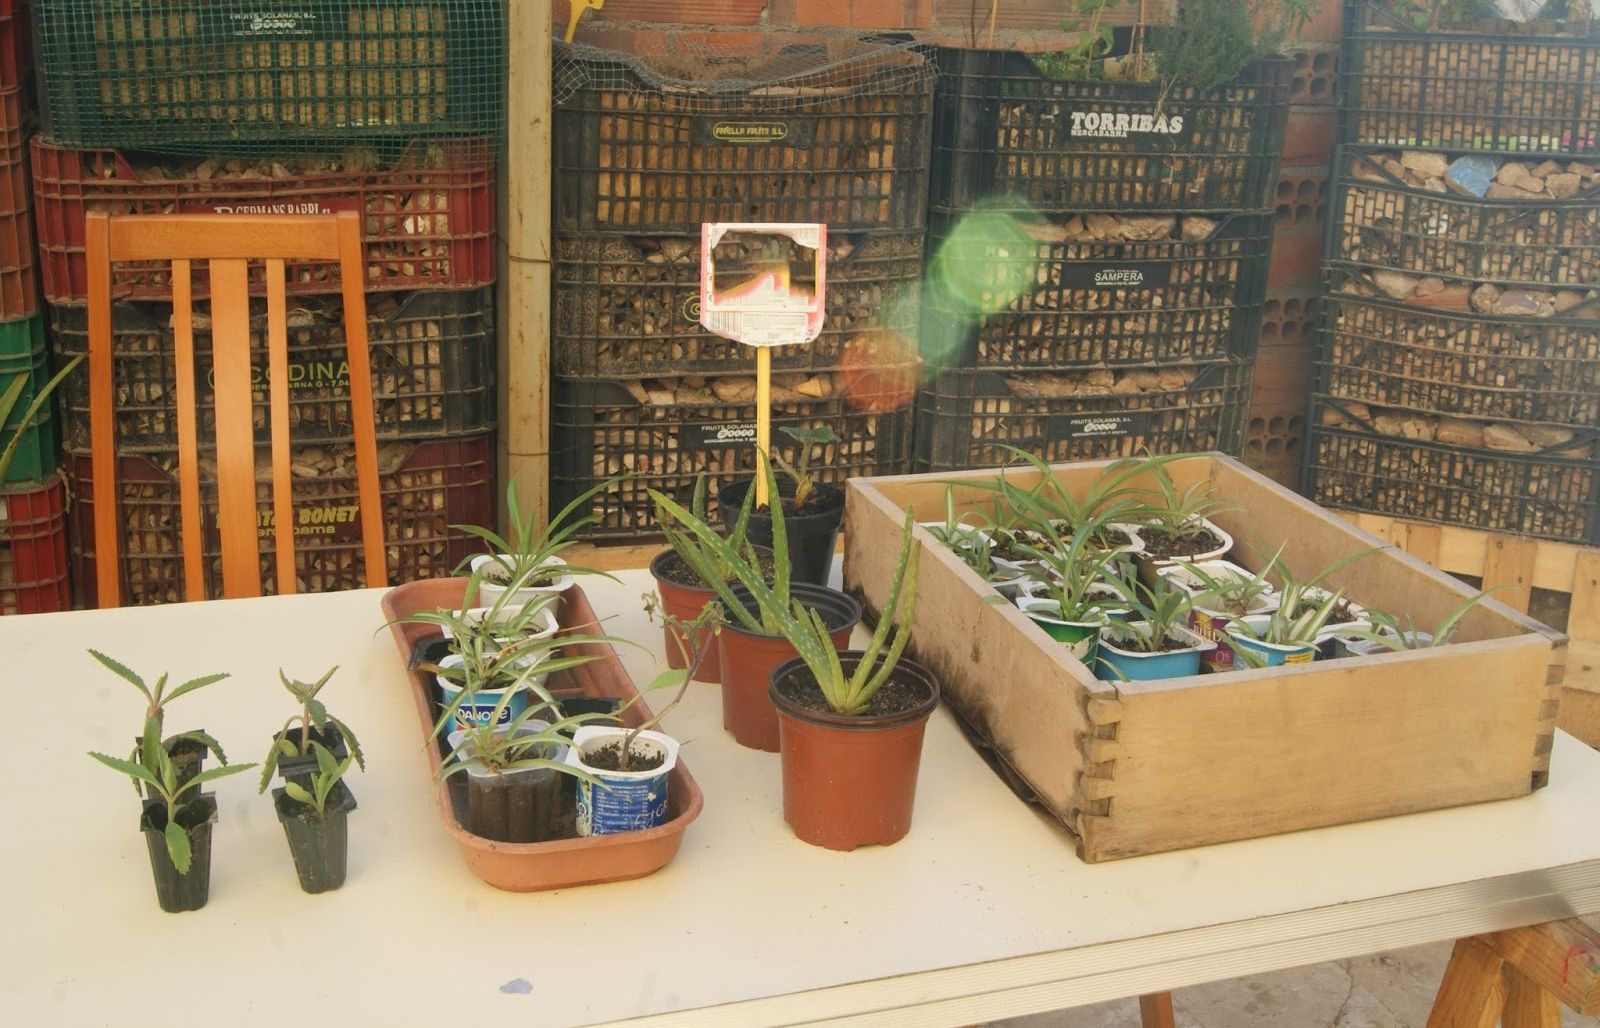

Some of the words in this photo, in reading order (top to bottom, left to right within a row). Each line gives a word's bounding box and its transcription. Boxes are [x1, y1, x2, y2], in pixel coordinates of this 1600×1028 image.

[1070, 111, 1184, 133] TORRIBAS
[1094, 272, 1144, 281] SAMPERA
[299, 505, 359, 524] BONET
